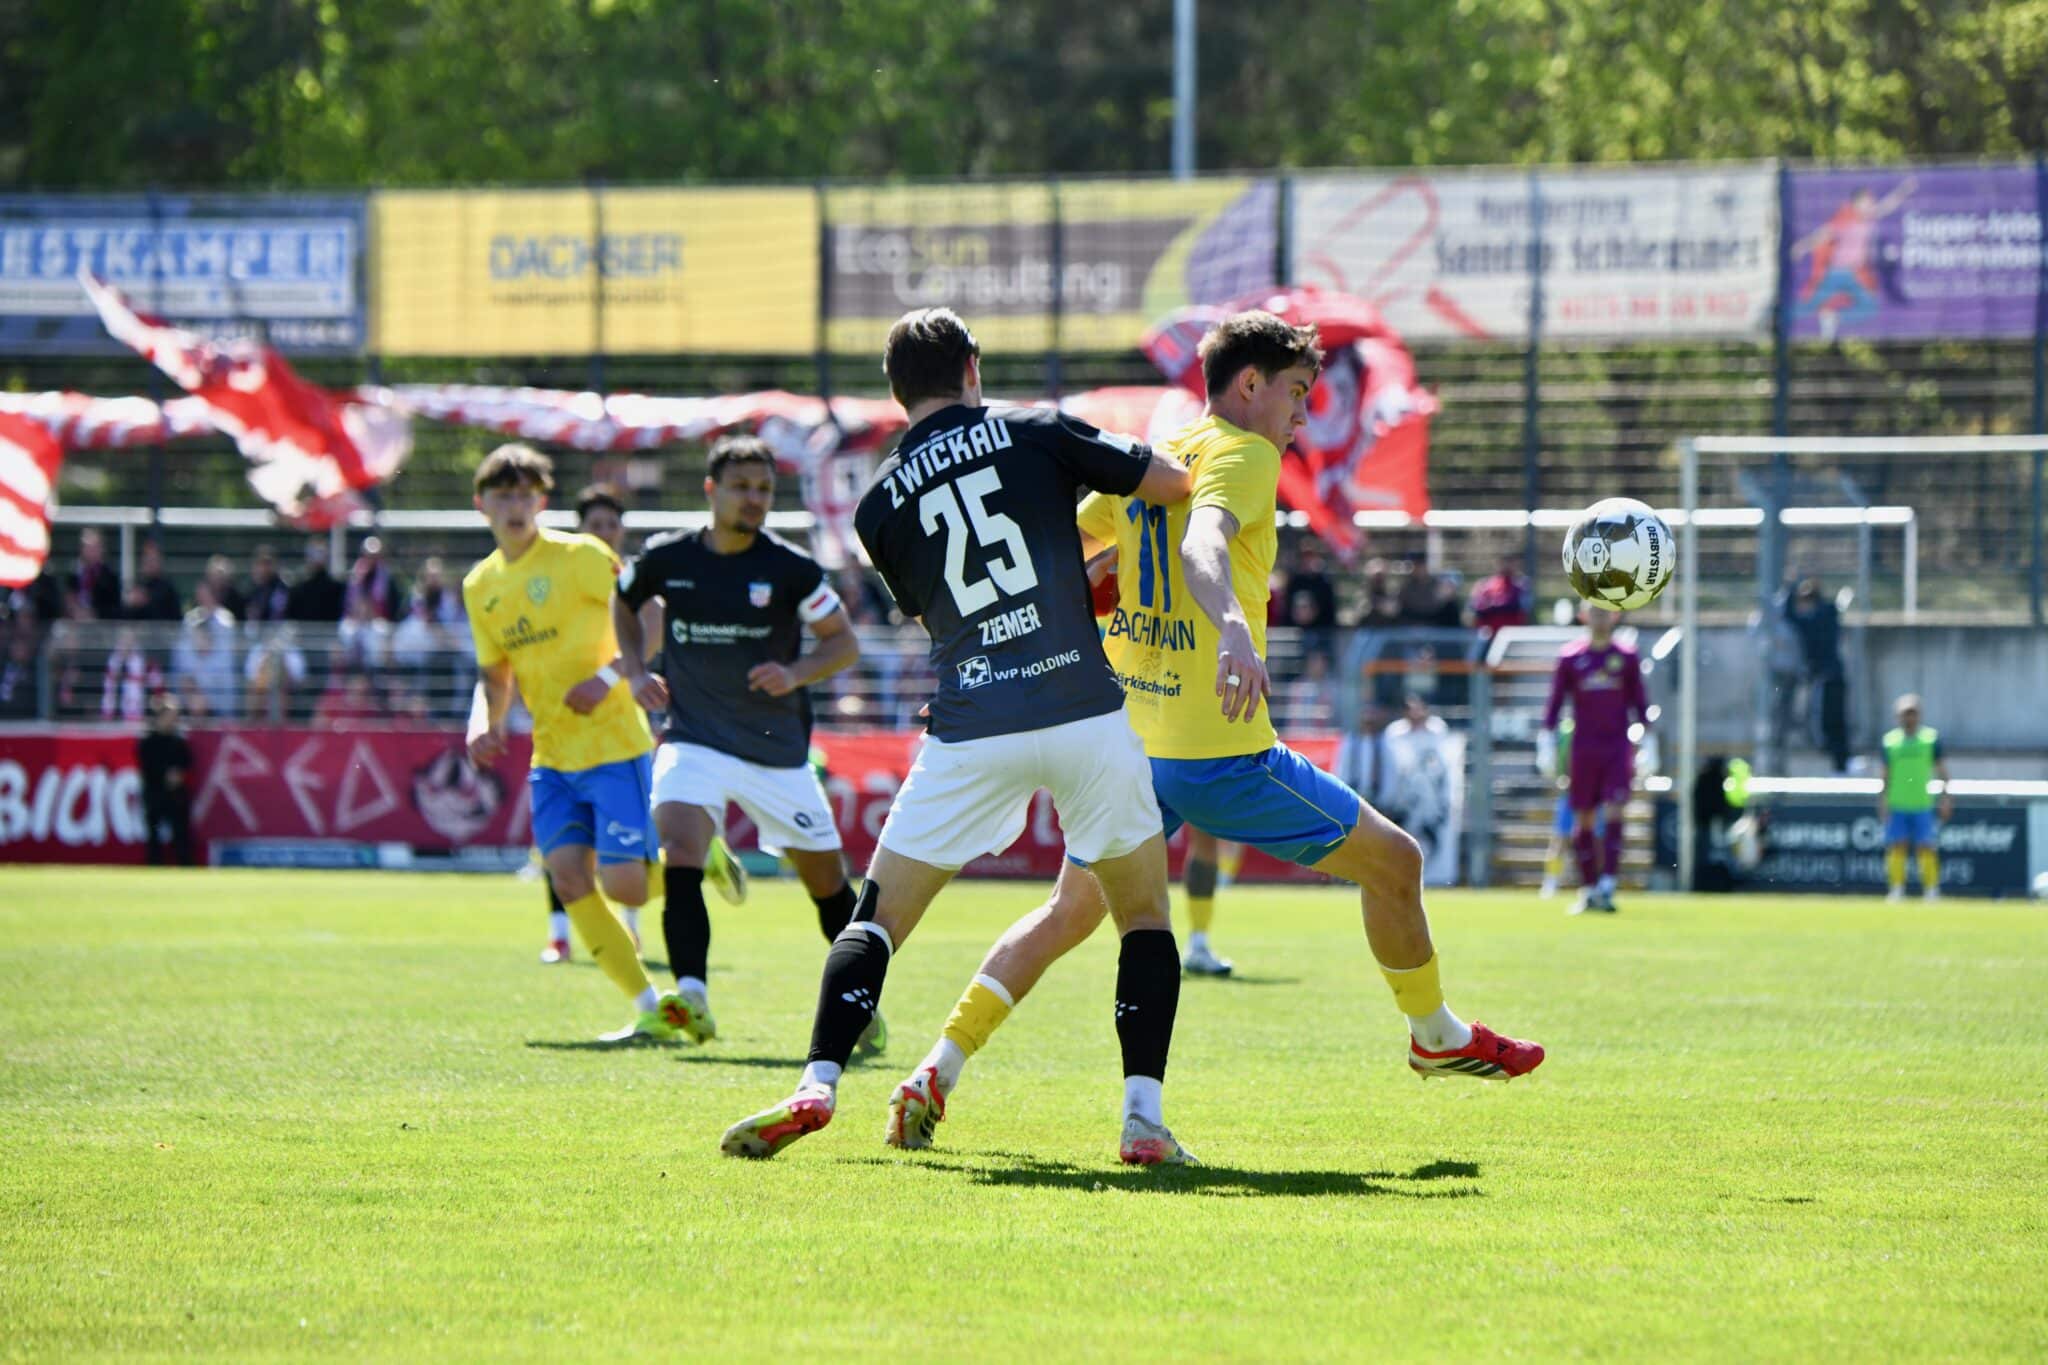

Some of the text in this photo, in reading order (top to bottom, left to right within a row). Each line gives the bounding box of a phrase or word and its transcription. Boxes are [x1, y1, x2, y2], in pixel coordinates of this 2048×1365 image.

[488, 233, 684, 280] DACHSER
[918, 465, 1039, 618] 25
[1126, 497, 1171, 614] 11
[1645, 525, 1661, 585] DERBYSTAR
[994, 649, 1081, 681] WP HOLDING
